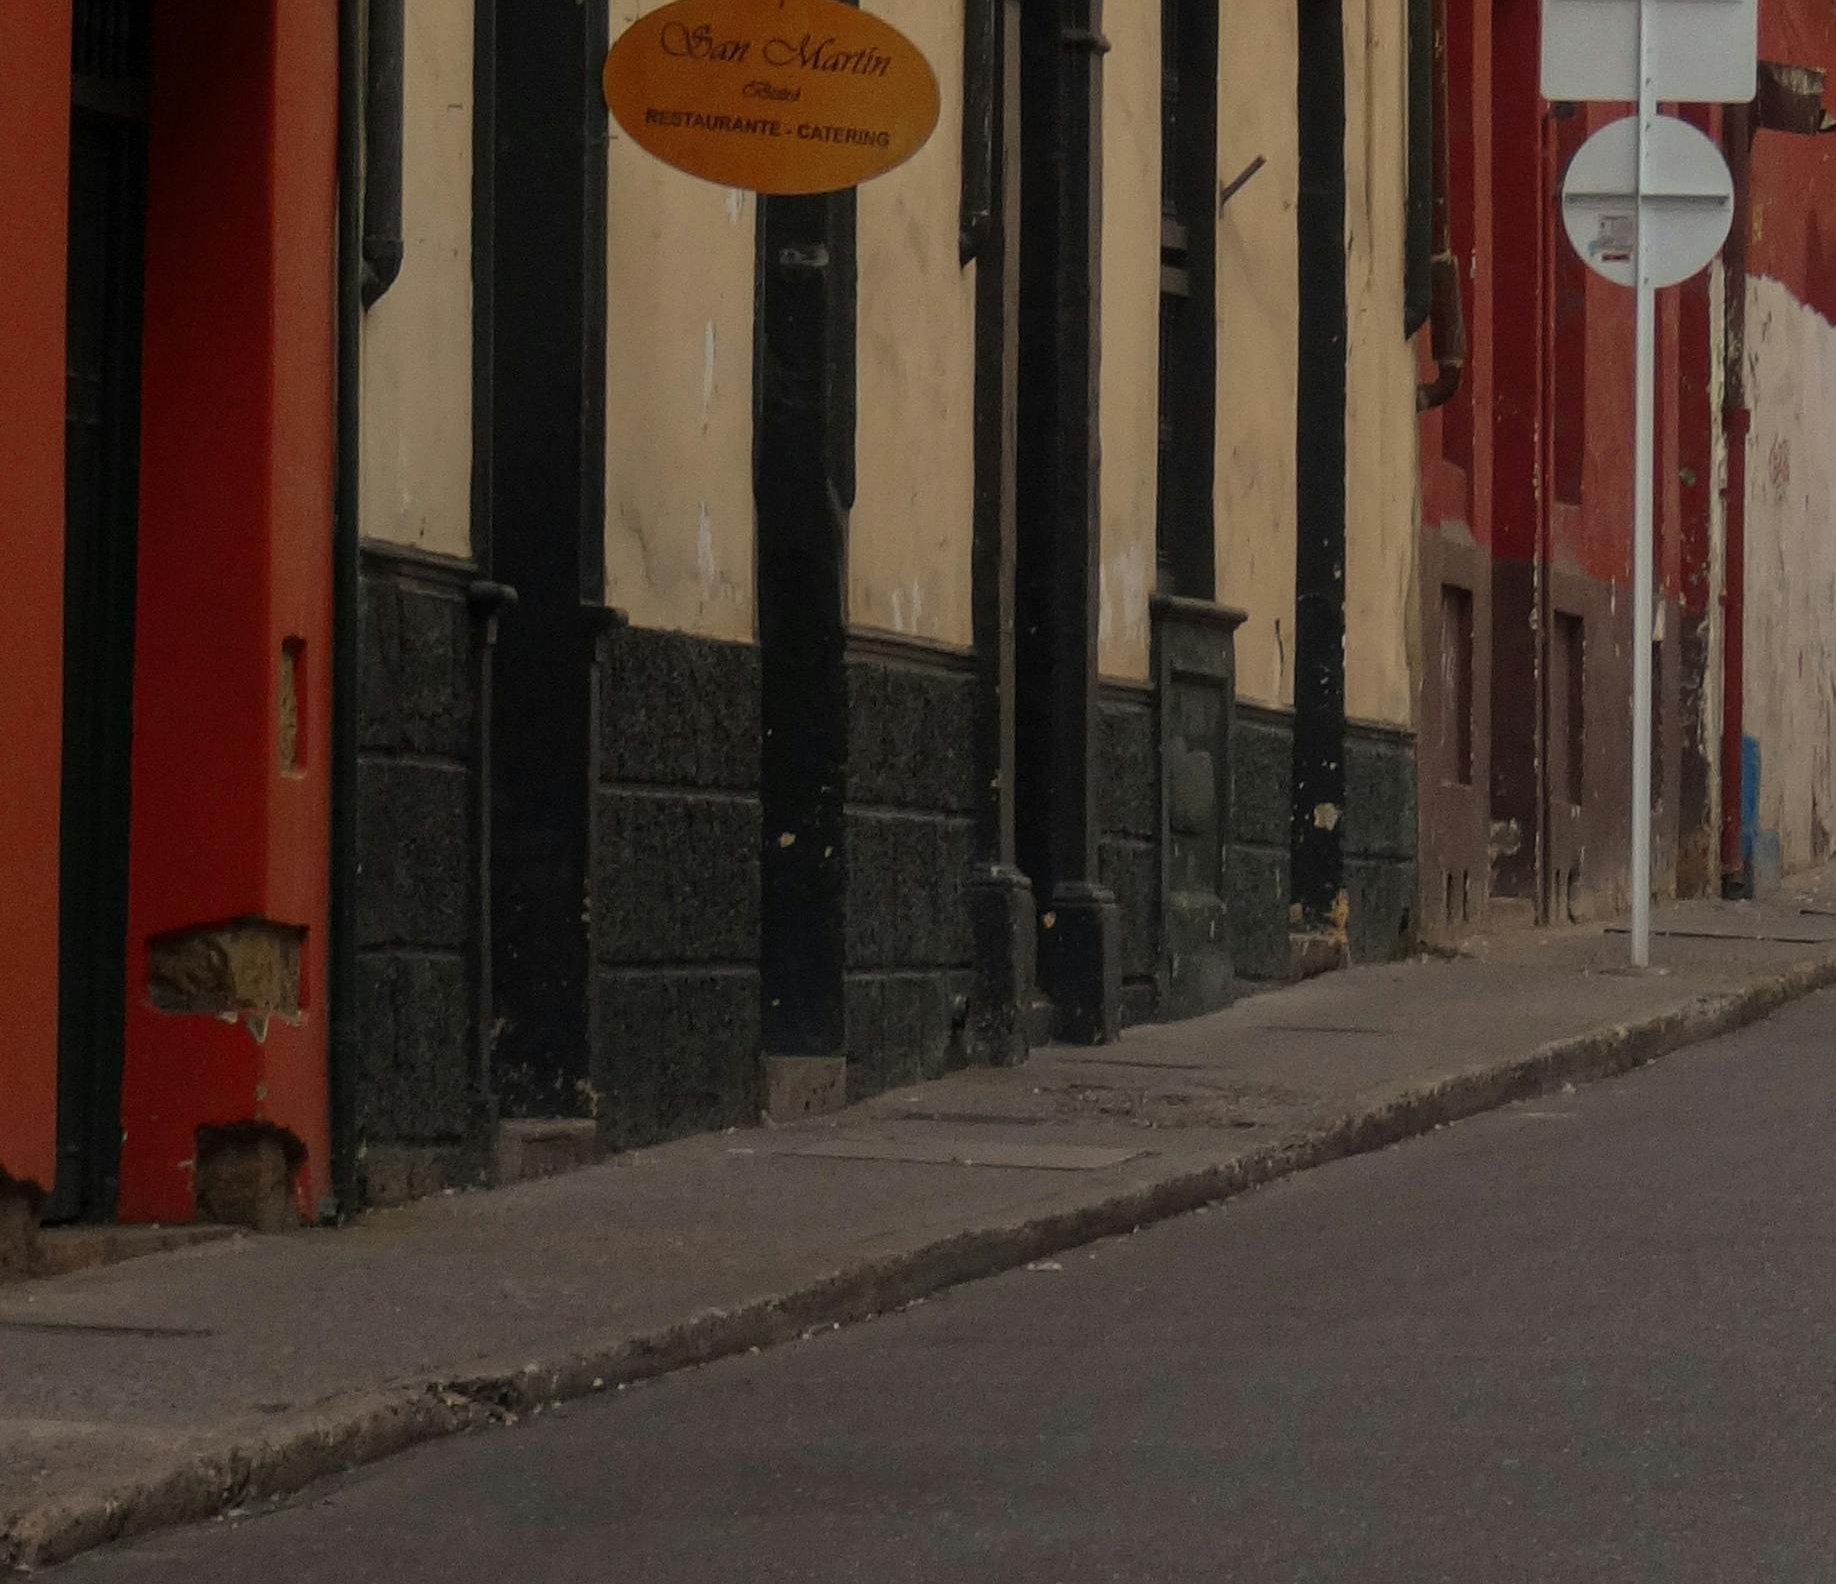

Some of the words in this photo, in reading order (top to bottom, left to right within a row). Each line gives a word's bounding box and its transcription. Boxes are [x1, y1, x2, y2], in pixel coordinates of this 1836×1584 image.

[661, 20, 751, 63] San
[644, 107, 781, 137] RESTAURANTE
[797, 124, 890, 148] CATERING
